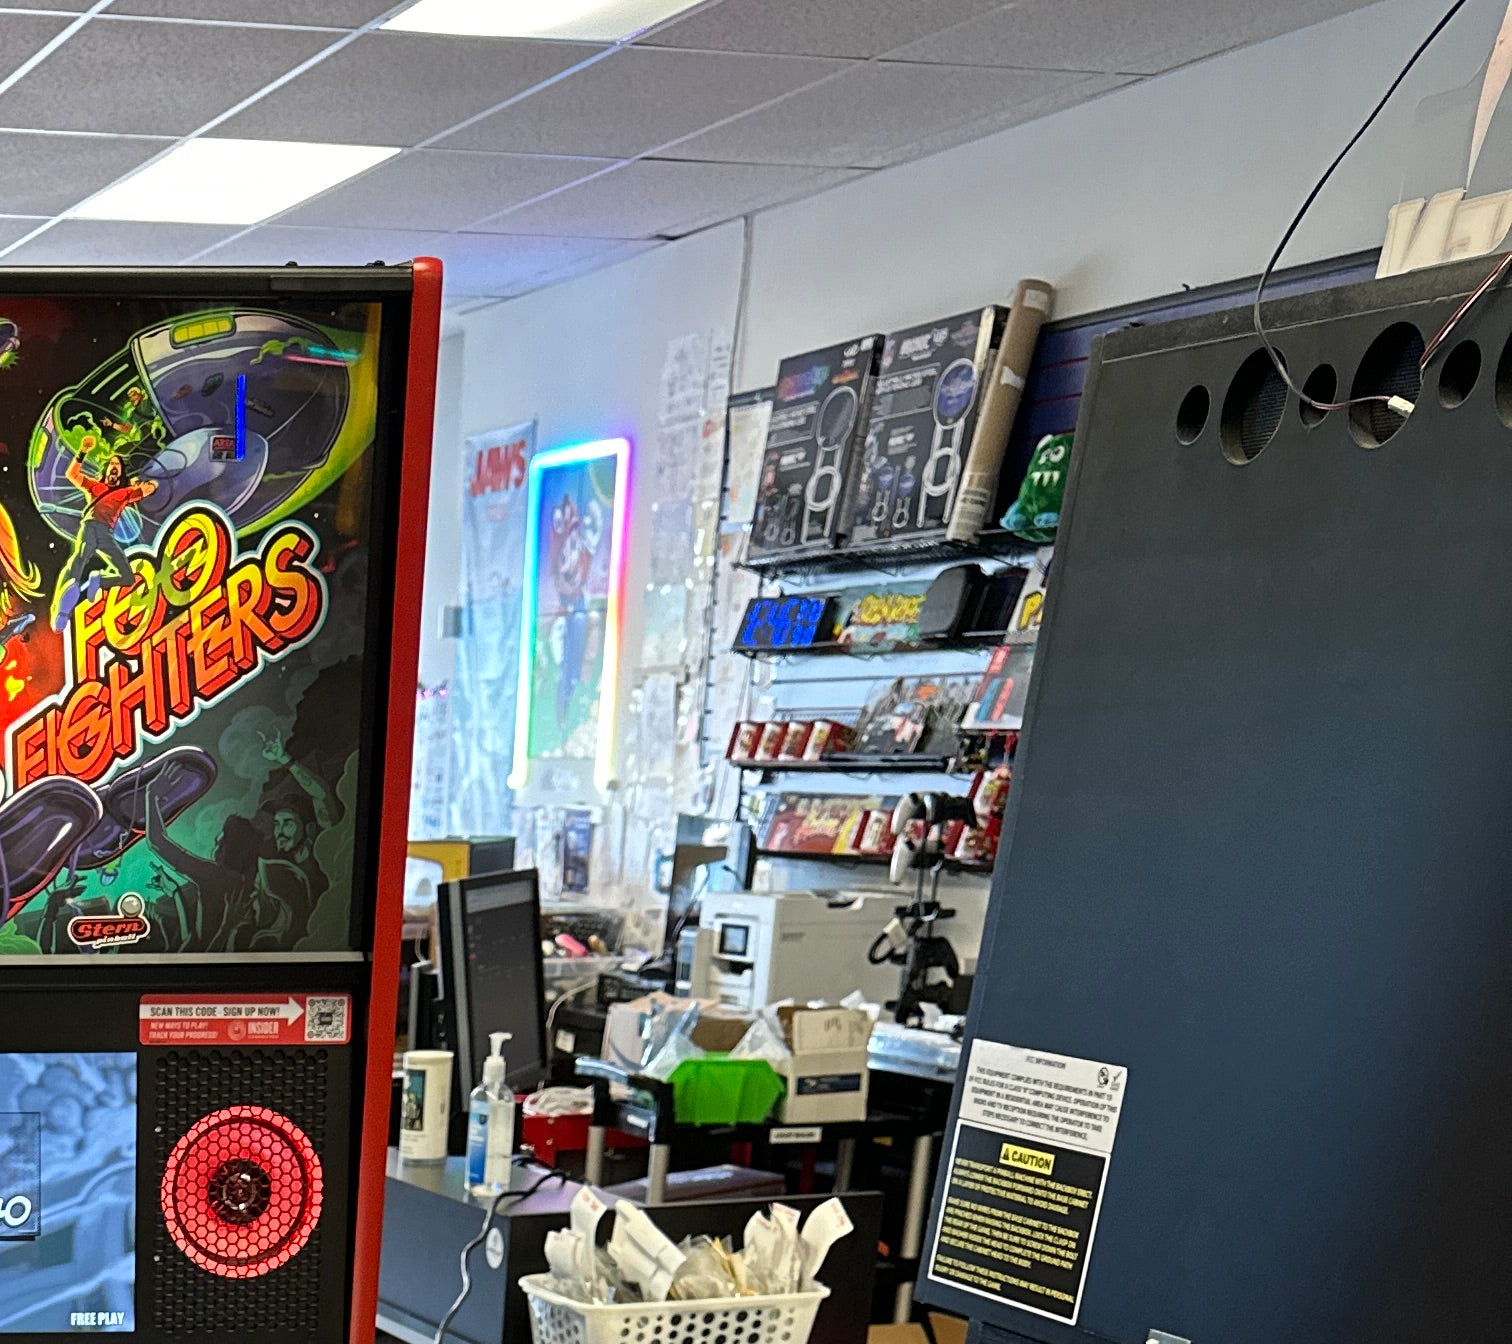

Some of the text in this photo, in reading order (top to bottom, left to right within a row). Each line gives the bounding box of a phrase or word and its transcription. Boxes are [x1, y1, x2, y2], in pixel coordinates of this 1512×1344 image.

[469, 439, 527, 498] JAWS
[73, 511, 233, 686] FOO
[14, 532, 317, 787] FIGHTERS
[77, 922, 141, 938] Stern
[150, 1006, 281, 1017] SCAN THIS CODE SIGN UP NOW!
[247, 1021, 279, 1035] INSIDER
[1011, 1150, 1051, 1171] CAUTION
[70, 1312, 125, 1326] FREE PLAY
